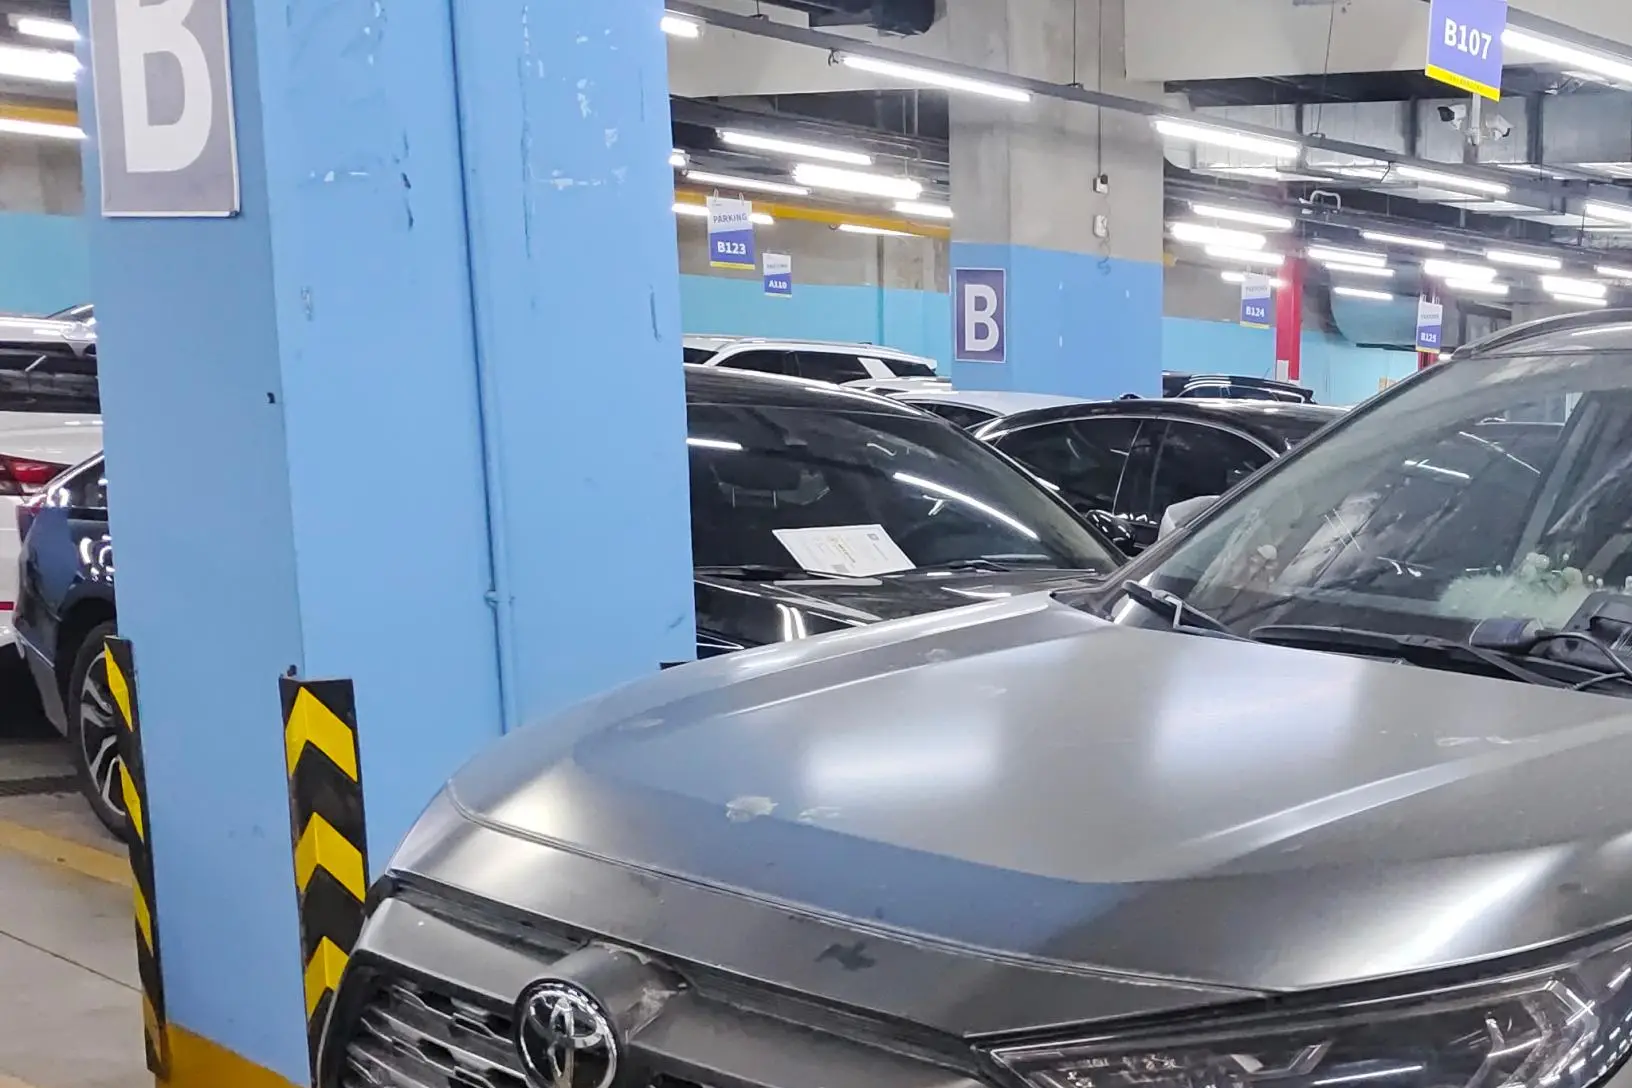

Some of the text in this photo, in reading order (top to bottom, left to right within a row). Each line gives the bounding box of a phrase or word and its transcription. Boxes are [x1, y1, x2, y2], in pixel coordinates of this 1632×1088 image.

[1444, 16, 1492, 61] B107
[115, 0, 213, 173] B
[713, 212, 748, 224] PARKING
[717, 240, 747, 255] B123
[768, 279, 788, 289] A110
[964, 283, 1000, 352] B
[1245, 305, 1266, 318] B124
